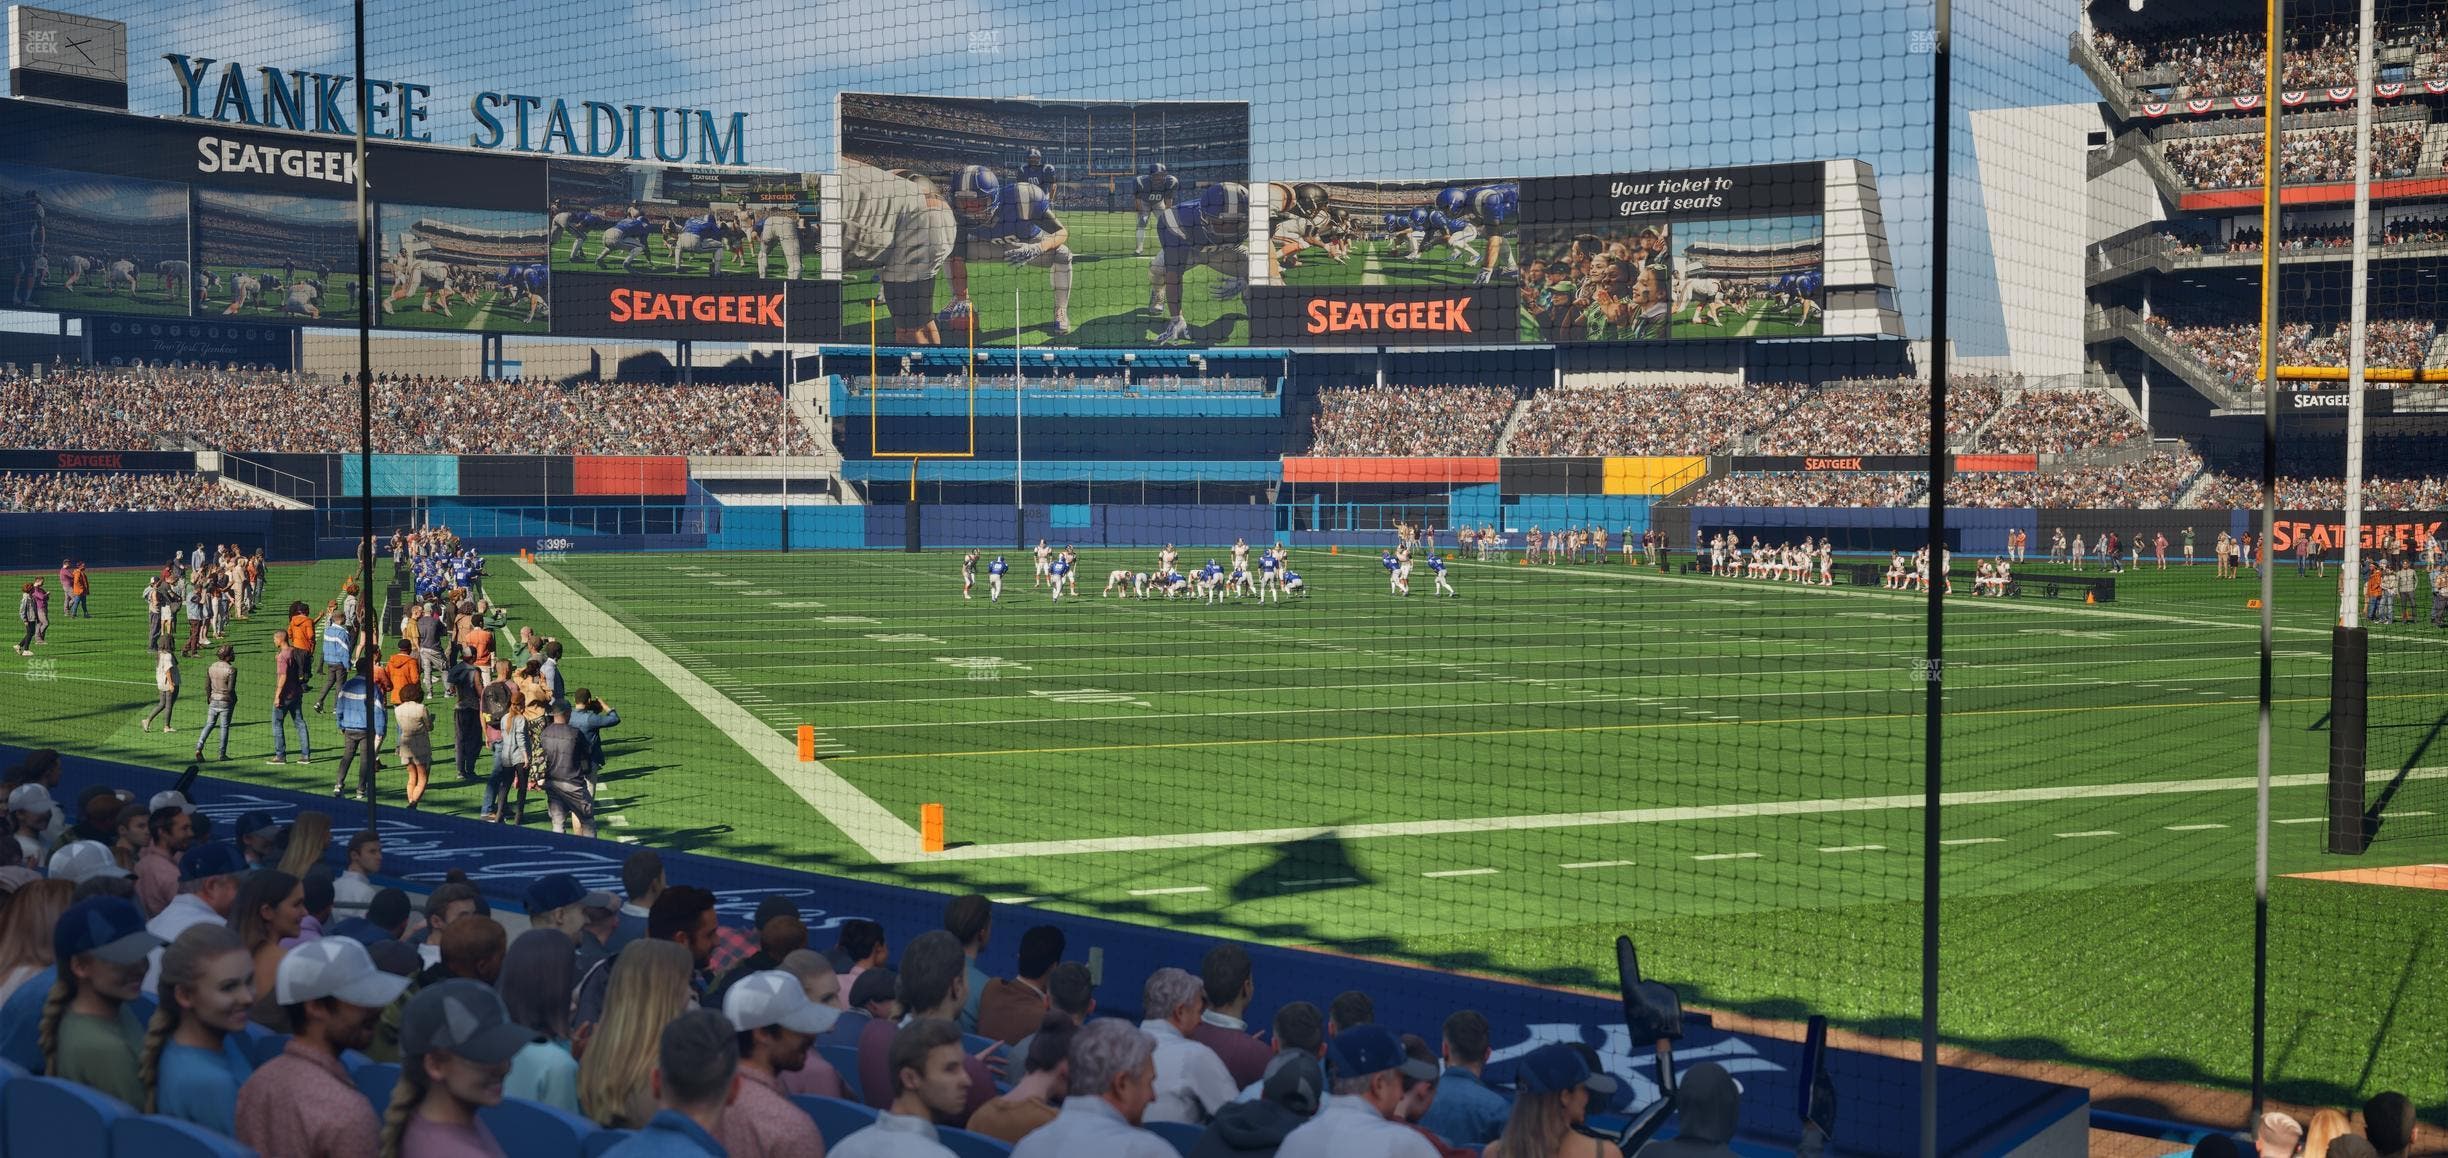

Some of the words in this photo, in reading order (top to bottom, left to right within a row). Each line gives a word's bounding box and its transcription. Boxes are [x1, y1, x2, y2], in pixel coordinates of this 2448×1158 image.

[161, 53, 431, 142] YANKEE
[470, 91, 749, 166] STADIUM
[197, 136, 372, 188] SEATGEEK
[1610, 182, 1655, 198] Your
[1658, 178, 1710, 194] ticket
[1715, 176, 1733, 190] to
[1620, 196, 1671, 216] great
[1673, 194, 1722, 210] seats
[610, 287, 784, 328] SEATGEEK
[1307, 296, 1473, 334] SEATGEEK
[2294, 394, 2350, 408] SEATGEE
[57, 452, 123, 470] SEATGEEK
[1805, 458, 1862, 470] SEATGEEK
